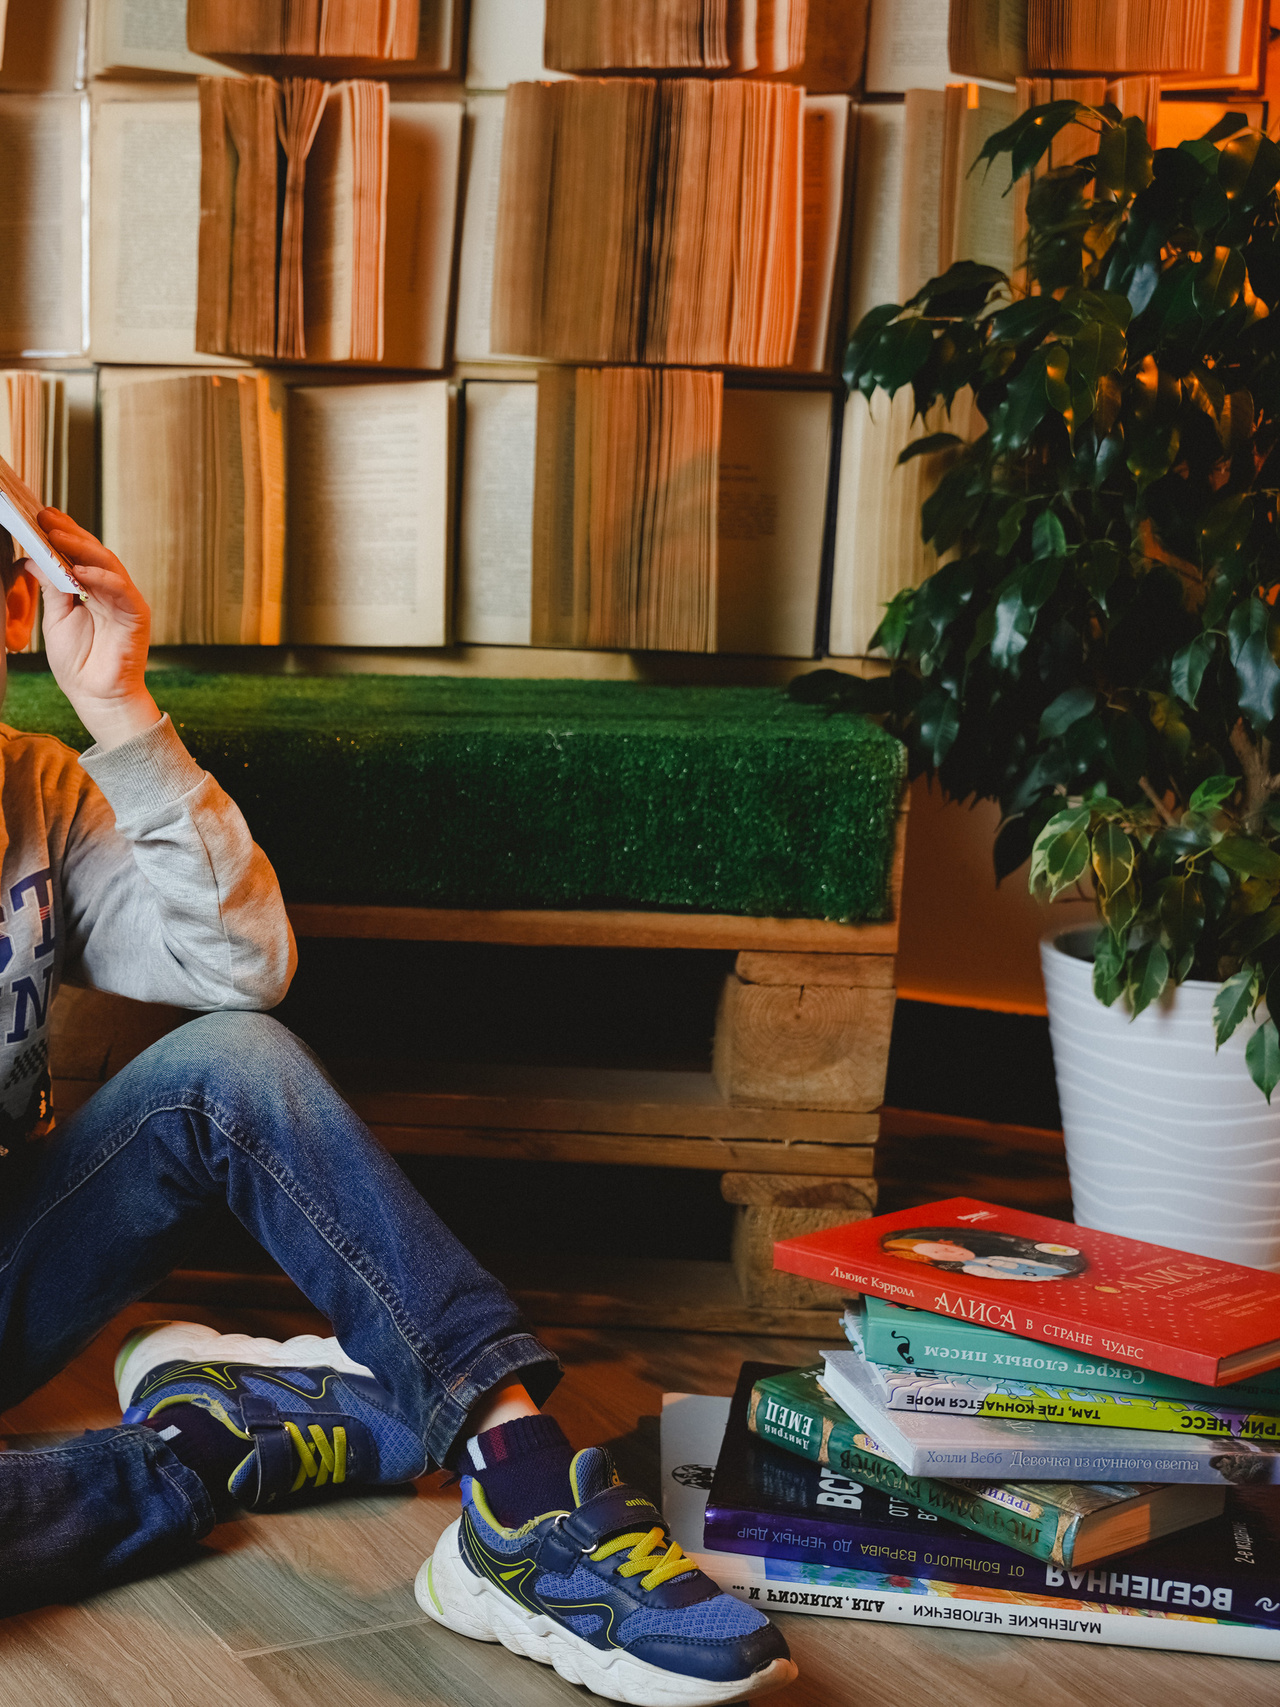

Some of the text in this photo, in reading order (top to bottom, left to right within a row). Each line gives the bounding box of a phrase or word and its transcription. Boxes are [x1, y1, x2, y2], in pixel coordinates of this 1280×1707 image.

[830, 1266, 915, 1298] Льюис Кэрролл
[934, 1292, 1017, 1331] АЛИСА
[1043, 1323, 1093, 1347] СТРАНЕ
[1101, 1338, 1144, 1360] ЧУДЕС
[923, 1345, 1145, 1385] Секрет еловых писем
[764, 1397, 813, 1437] ЕМЕЦ
[906, 1395, 1101, 1420] ТАМ, ГДЕ КОНЧАЕТСЯ МОРЕ
[764, 1423, 810, 1450] Дмитрий
[1181, 1415, 1232, 1432] НЕСС
[926, 1450, 1200, 1472] Холли Вебб Девочка из лунного света
[737, 1527, 1233, 1612] ВСЕЛЕННАЯ ОТ БОЛЬШОГО ВЗРЫВА ДО ЧЕРНЫХ ДЫР
[766, 1588, 843, 1609] КЛЯКСИЧ
[913, 1604, 1003, 1625] ЧЕЛОВЕЧКИ
[1009, 1614, 1102, 1635] МАЛЕНЬКИЕ
